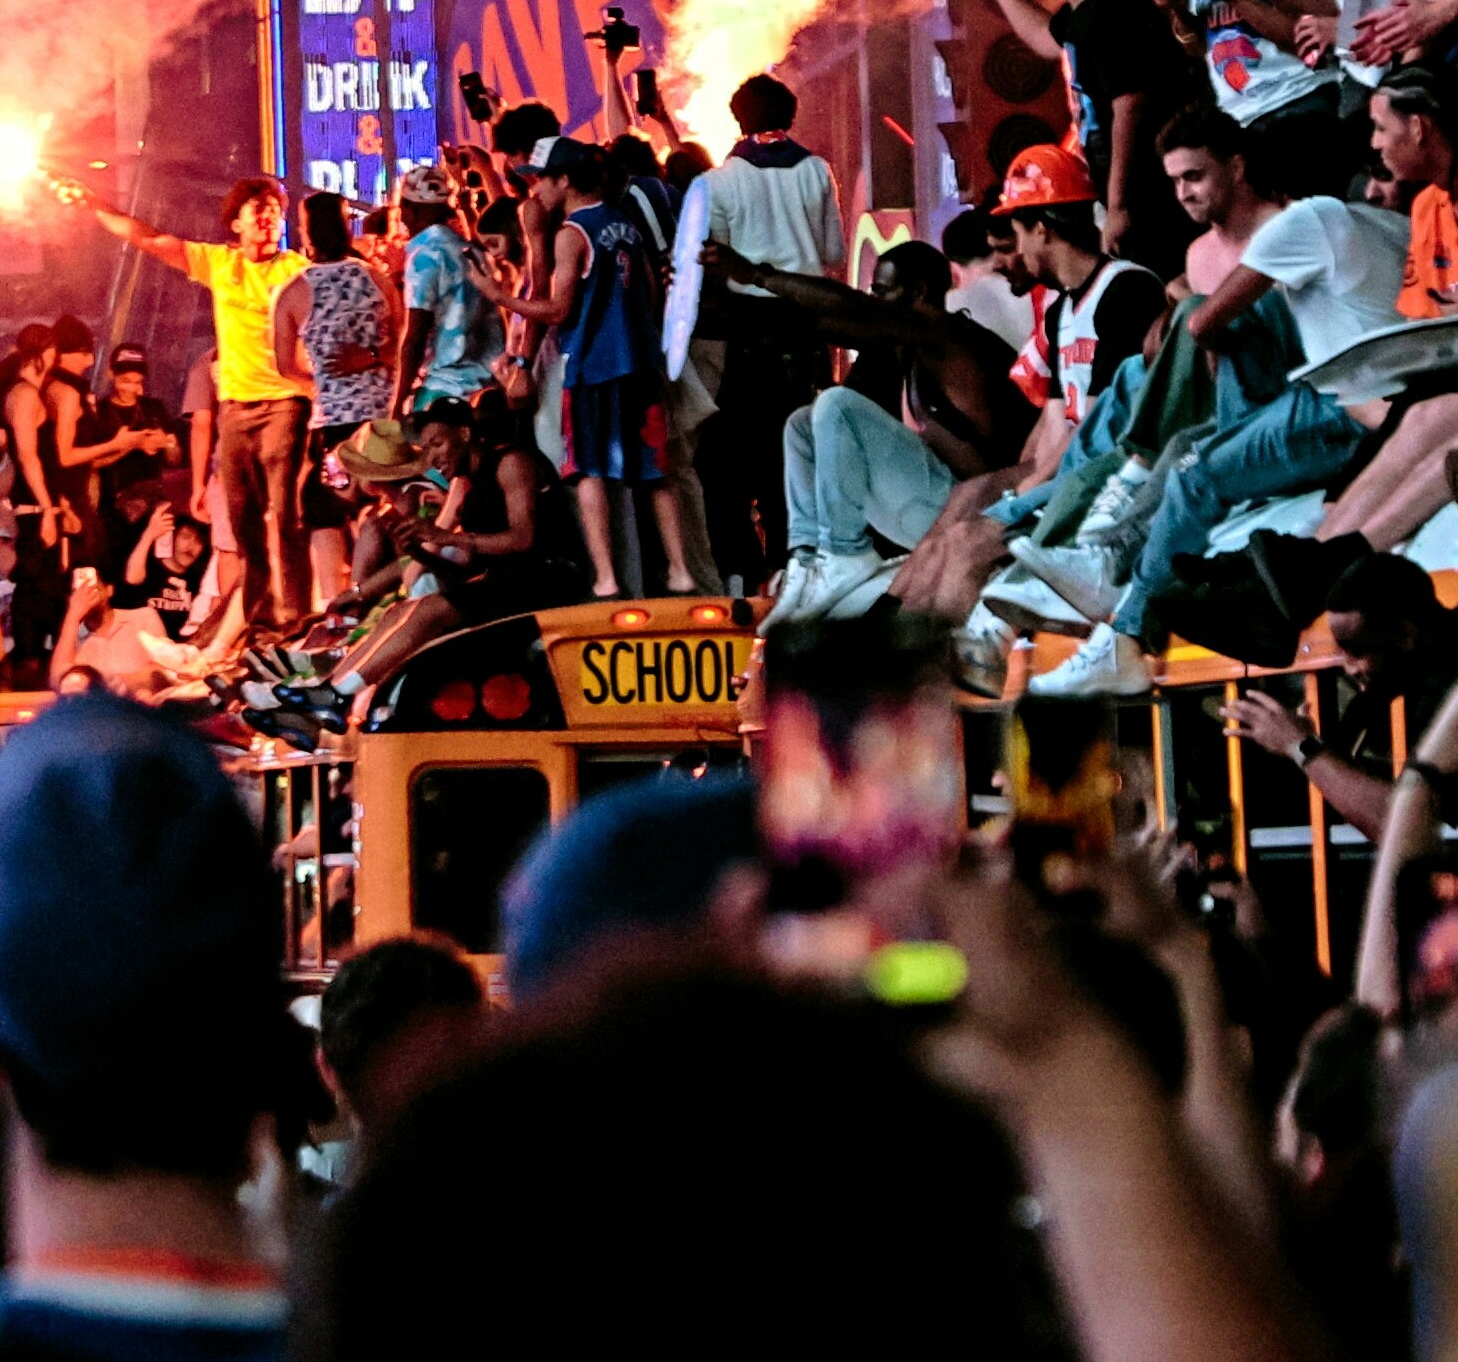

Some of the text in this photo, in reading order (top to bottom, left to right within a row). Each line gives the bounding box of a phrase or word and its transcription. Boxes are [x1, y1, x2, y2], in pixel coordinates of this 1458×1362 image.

[354, 16, 377, 57] &
[355, 113, 384, 155] &
[582, 638, 740, 705] SCHOOL
